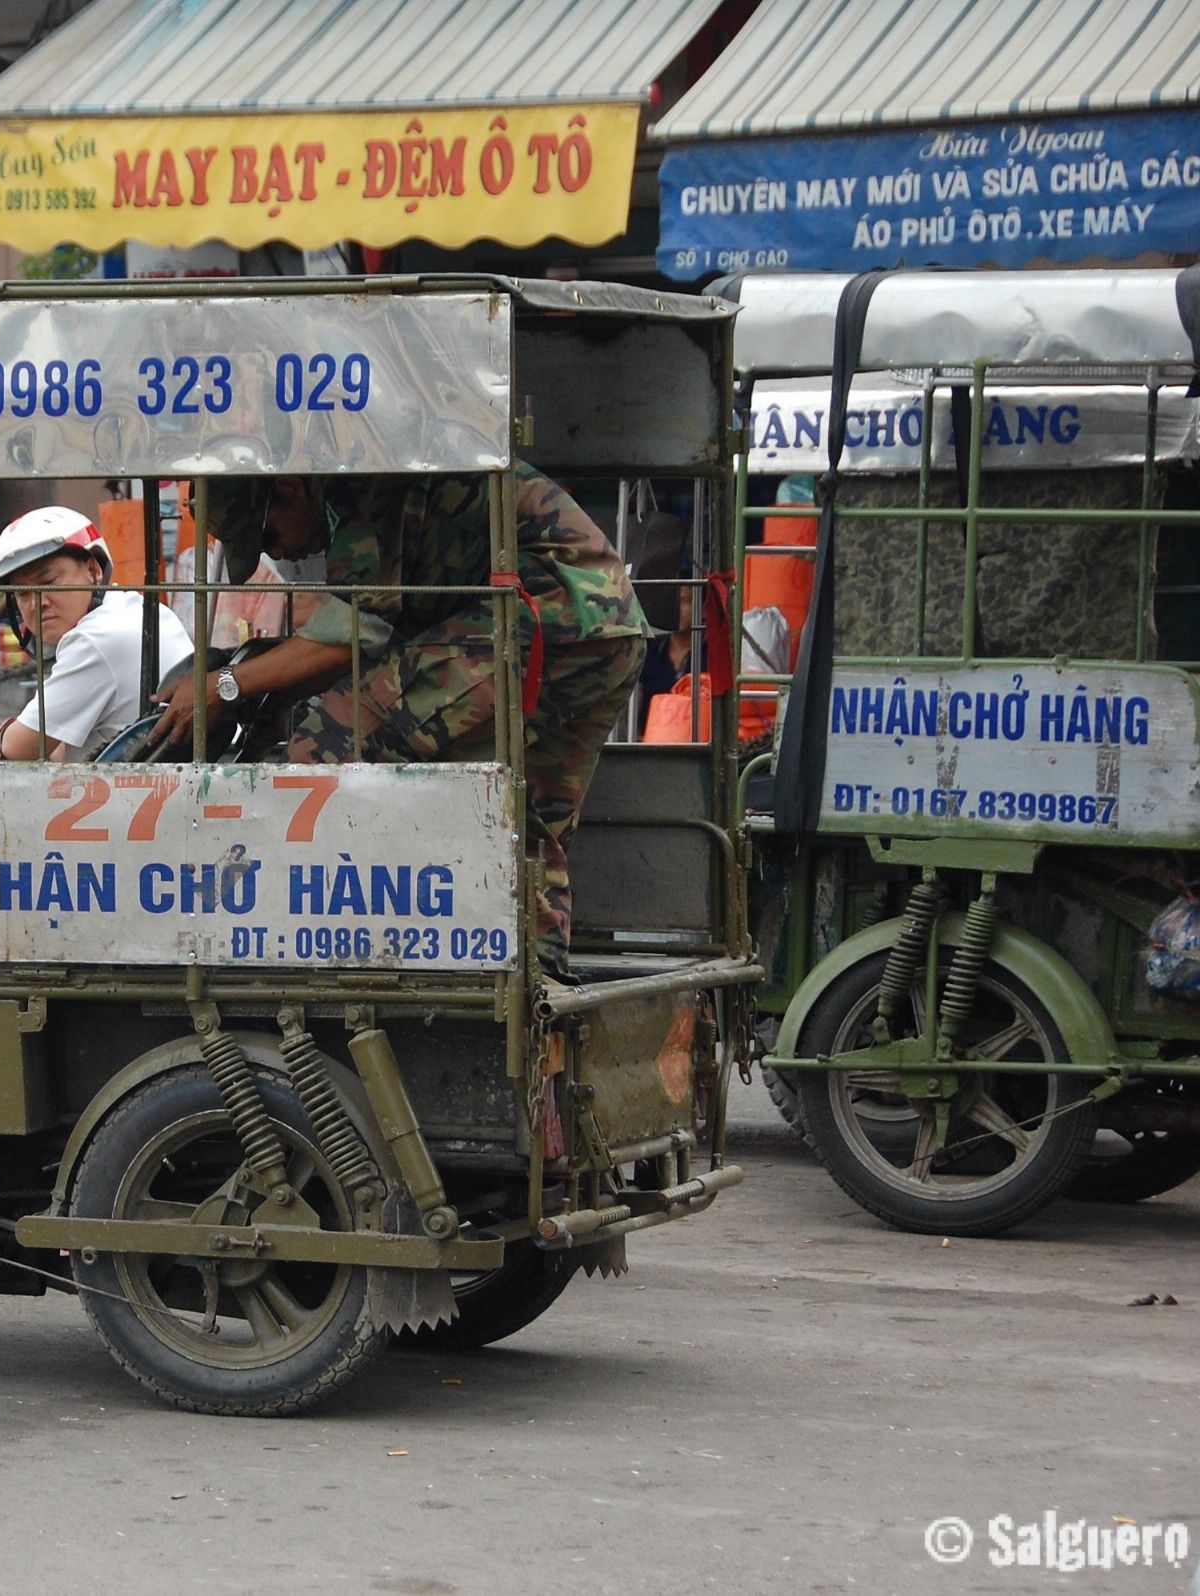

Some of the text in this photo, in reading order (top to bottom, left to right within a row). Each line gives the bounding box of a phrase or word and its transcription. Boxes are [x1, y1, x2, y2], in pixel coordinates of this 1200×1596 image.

[112, 148, 218, 208] MAY
[229, 142, 326, 217] BẠT
[362, 117, 467, 213] ĐỆM
[479, 114, 514, 195] Ô
[528, 112, 593, 193] TÔ
[680, 150, 1200, 216] CHUYÊN MAY MỚI VÀ SỬA CHỮA CÁC
[853, 213, 892, 248] ÁO
[901, 206, 955, 246] PHỦ
[1083, 197, 1155, 236] MÁY
[137, 356, 232, 415] 323
[275, 352, 370, 412] 029
[948, 396, 1081, 446] ÀNG
[831, 677, 938, 746] NHẬN
[950, 674, 1029, 741] CHỞ
[834, 783, 1116, 824] ĐT: 0167.8399867
[139, 844, 262, 915] CHỞ
[289, 853, 454, 917] HÀNG
[296, 927, 371, 959] 0986
[383, 928, 440, 959] 323
[450, 927, 507, 961] 029
